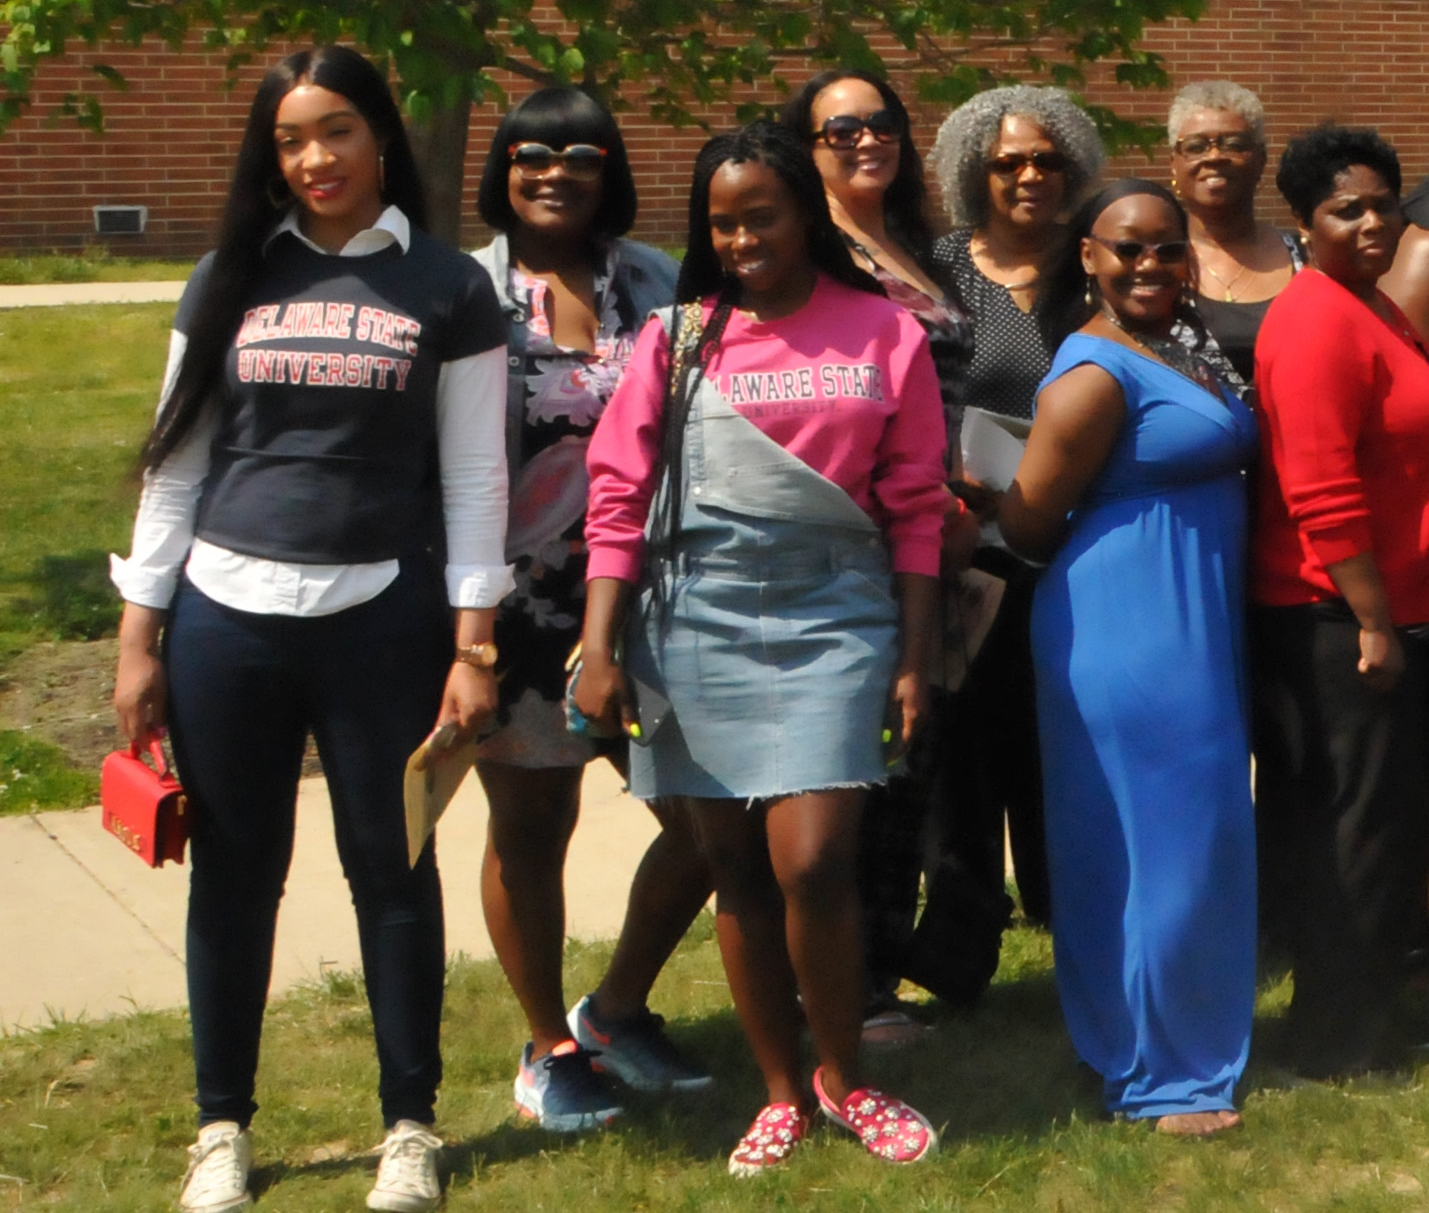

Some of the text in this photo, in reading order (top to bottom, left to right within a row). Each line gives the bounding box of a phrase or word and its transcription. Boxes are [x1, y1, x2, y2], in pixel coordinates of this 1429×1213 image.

[236, 302, 422, 357] DELAWARE STATE
[238, 350, 412, 391] UNIVERSITY
[714, 363, 885, 405] LAWARE STATE
